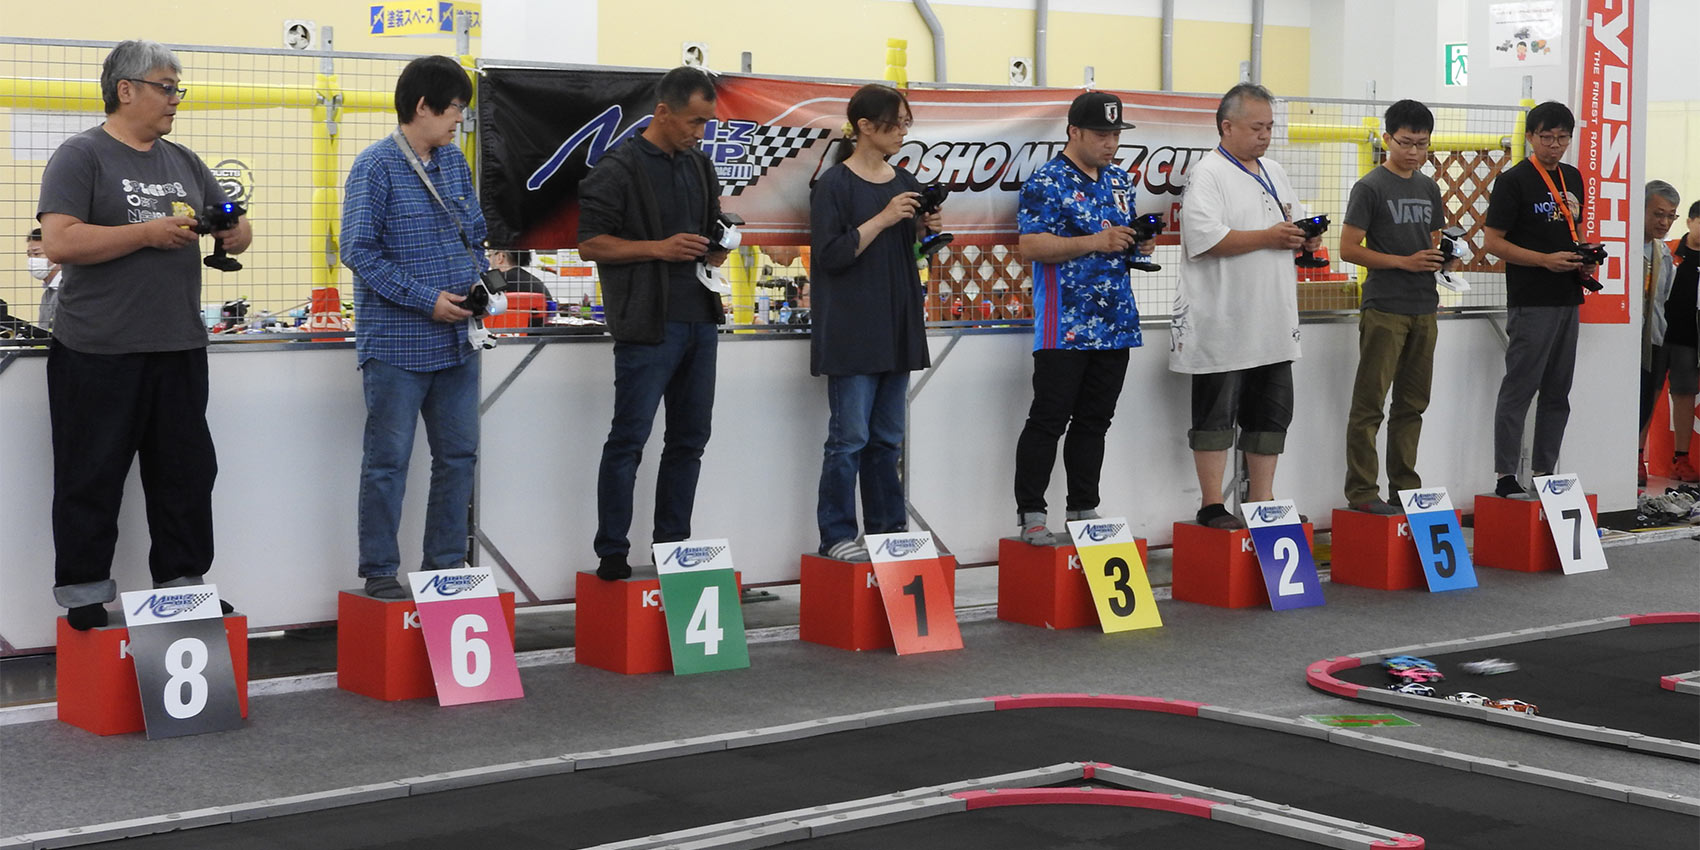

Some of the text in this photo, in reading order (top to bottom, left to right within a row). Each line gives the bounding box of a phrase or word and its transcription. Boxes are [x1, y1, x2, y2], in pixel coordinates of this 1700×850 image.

[387, 8, 434, 28] 塗装スペース
[1591, 81, 1600, 125] FINEST
[1146, 146, 1212, 195] CU
[1589, 131, 1598, 171] RADIO
[1387, 199, 1432, 224] VANS
[1534, 201, 1562, 214] NOR
[1547, 211, 1565, 222] FAC
[1586, 177, 1596, 238] CONTROL
[1429, 523, 1457, 579] 5
[1561, 508, 1582, 561] 7
[1104, 557, 1136, 617] 3
[1273, 537, 1304, 597] 2
[685, 585, 724, 656] 4
[902, 575, 928, 637] 1
[450, 613, 491, 688] 6
[163, 637, 209, 719] 8
